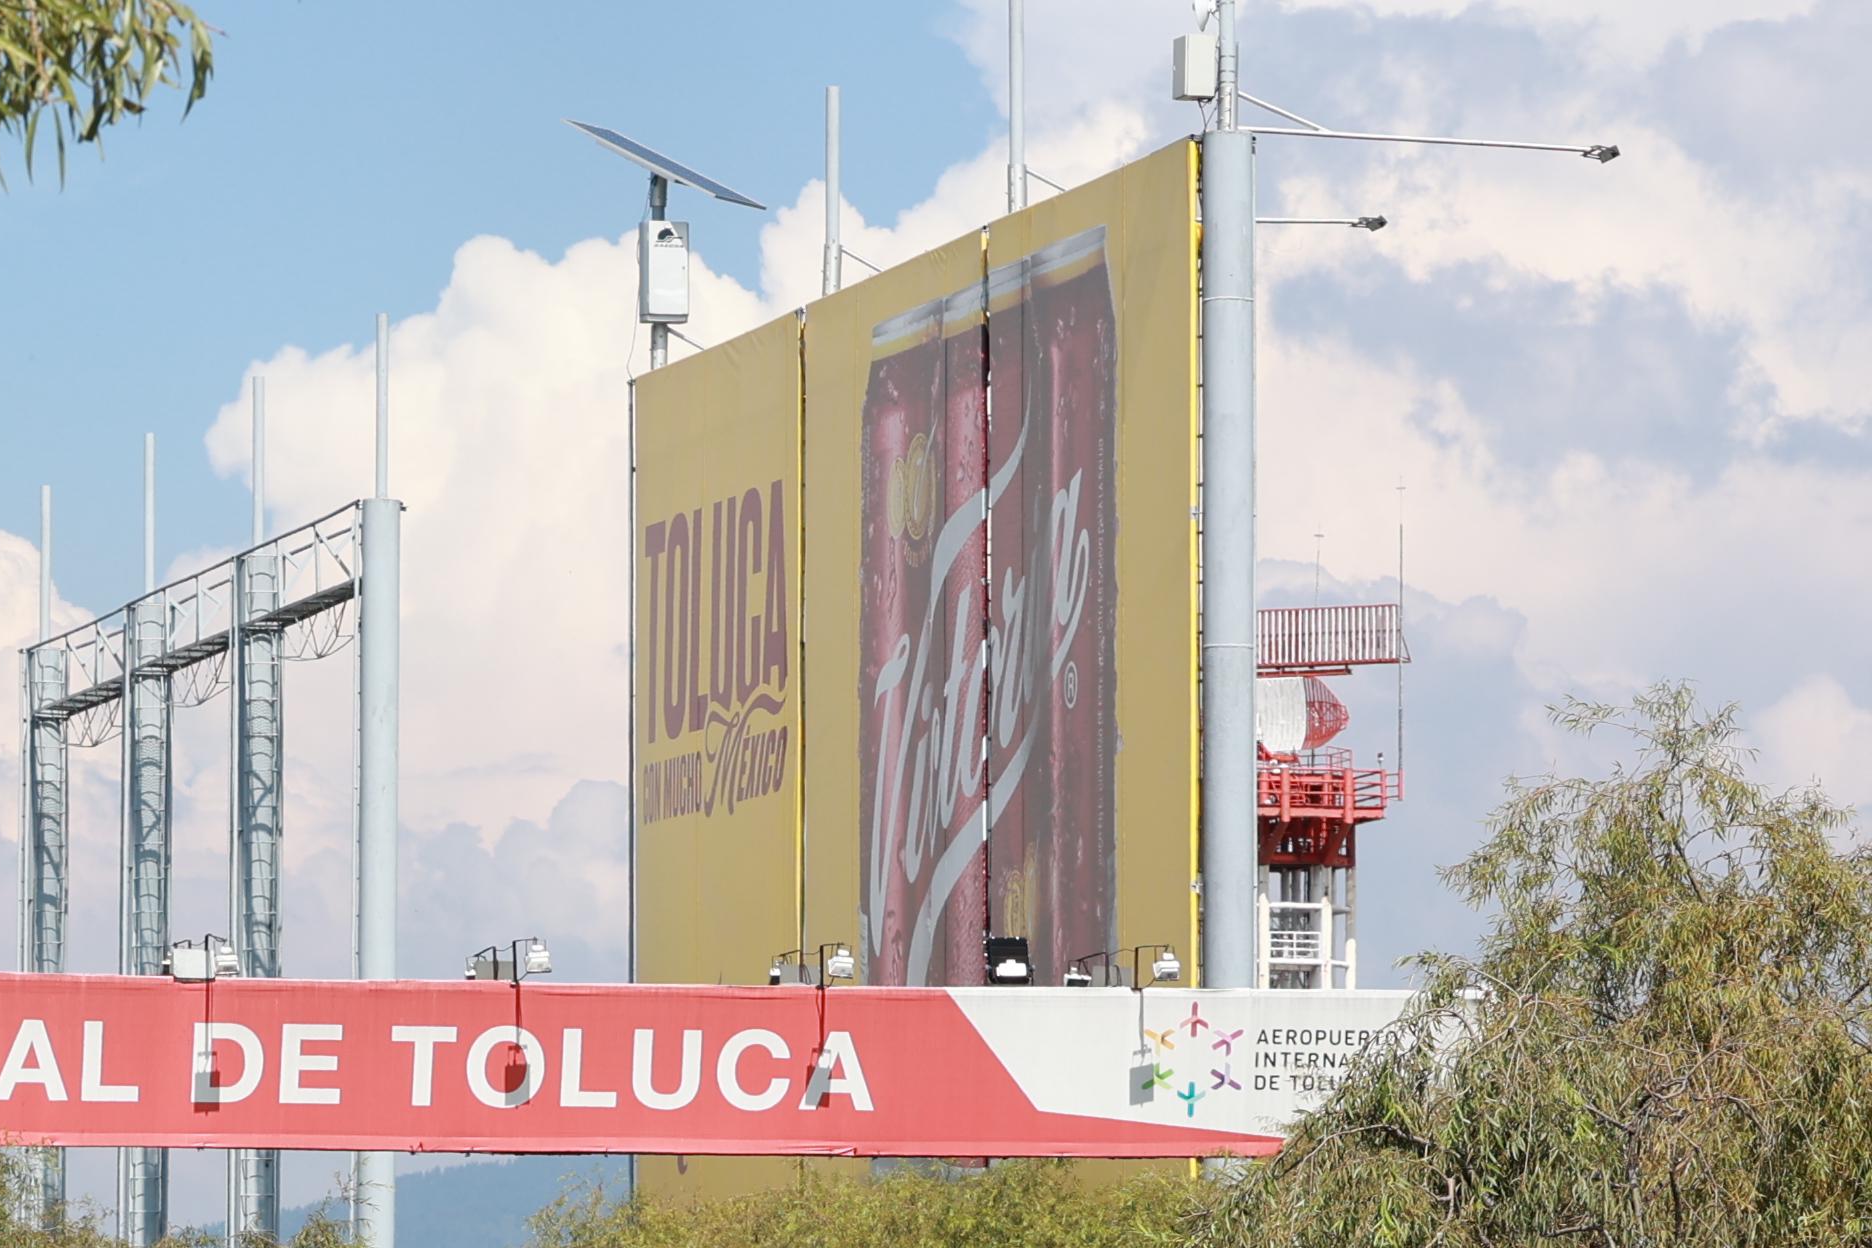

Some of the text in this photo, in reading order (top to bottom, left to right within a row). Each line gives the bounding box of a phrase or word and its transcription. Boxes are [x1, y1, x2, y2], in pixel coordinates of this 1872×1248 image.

[645, 480, 788, 744] TOLUCA
[663, 751, 702, 820] MUCHO
[190, 1021, 344, 1105] DE
[391, 1025, 876, 1113] TOLUCA
[1256, 1029, 1397, 1046] AEROPUERTO
[1254, 1075, 1280, 1091] DE
